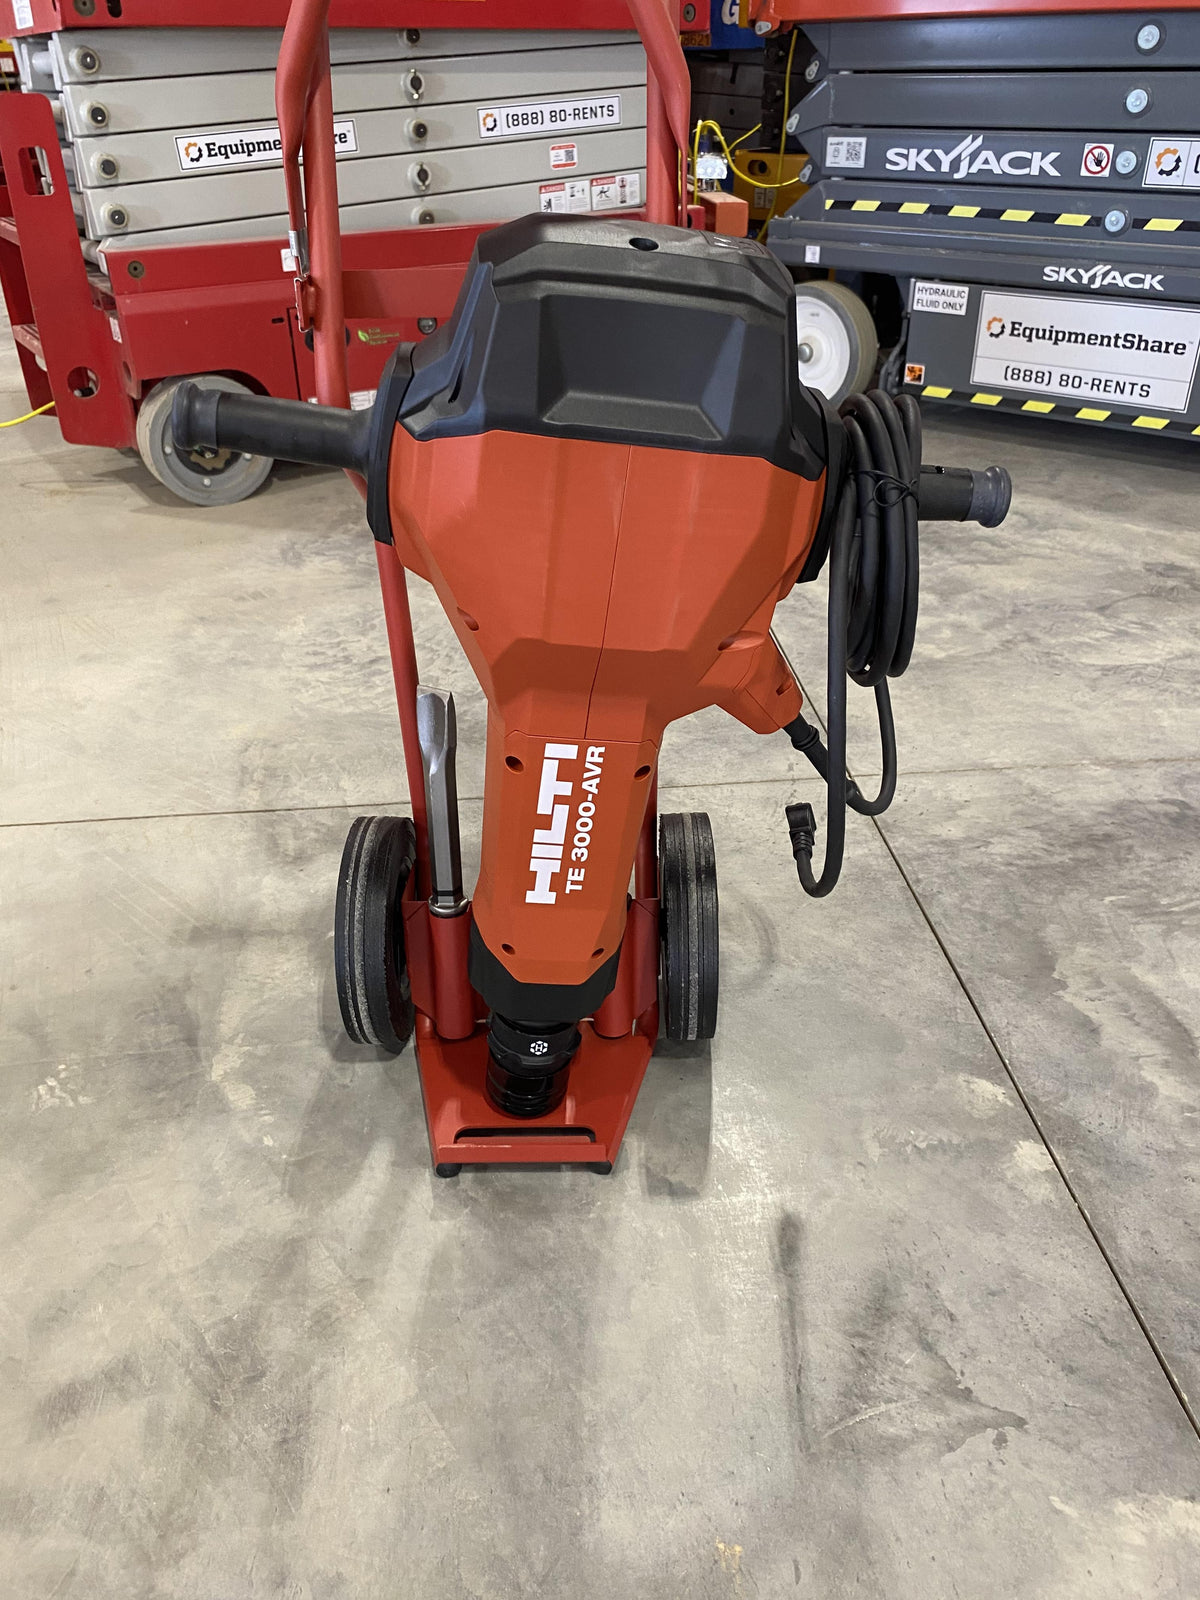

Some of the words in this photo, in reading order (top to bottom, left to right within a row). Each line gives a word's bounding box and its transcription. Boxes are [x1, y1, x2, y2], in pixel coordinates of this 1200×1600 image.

[506, 110, 544, 128] (888)
[549, 104, 615, 123] 80-RENTS
[885, 134, 1062, 179] SKYJACK
[917, 286, 966, 299] HYDRAULIC
[1042, 264, 1165, 291] SKYJACK
[916, 298, 940, 309] FLUID
[942, 301, 964, 312] ONLY
[1008, 320, 1188, 356] EquipmentShare
[1004, 365, 1052, 386] (888)
[1059, 373, 1151, 398] 80-RENTS
[571, 745, 606, 862] 3000-AVR
[525, 742, 579, 904] HILTI
[565, 867, 586, 894] TE
